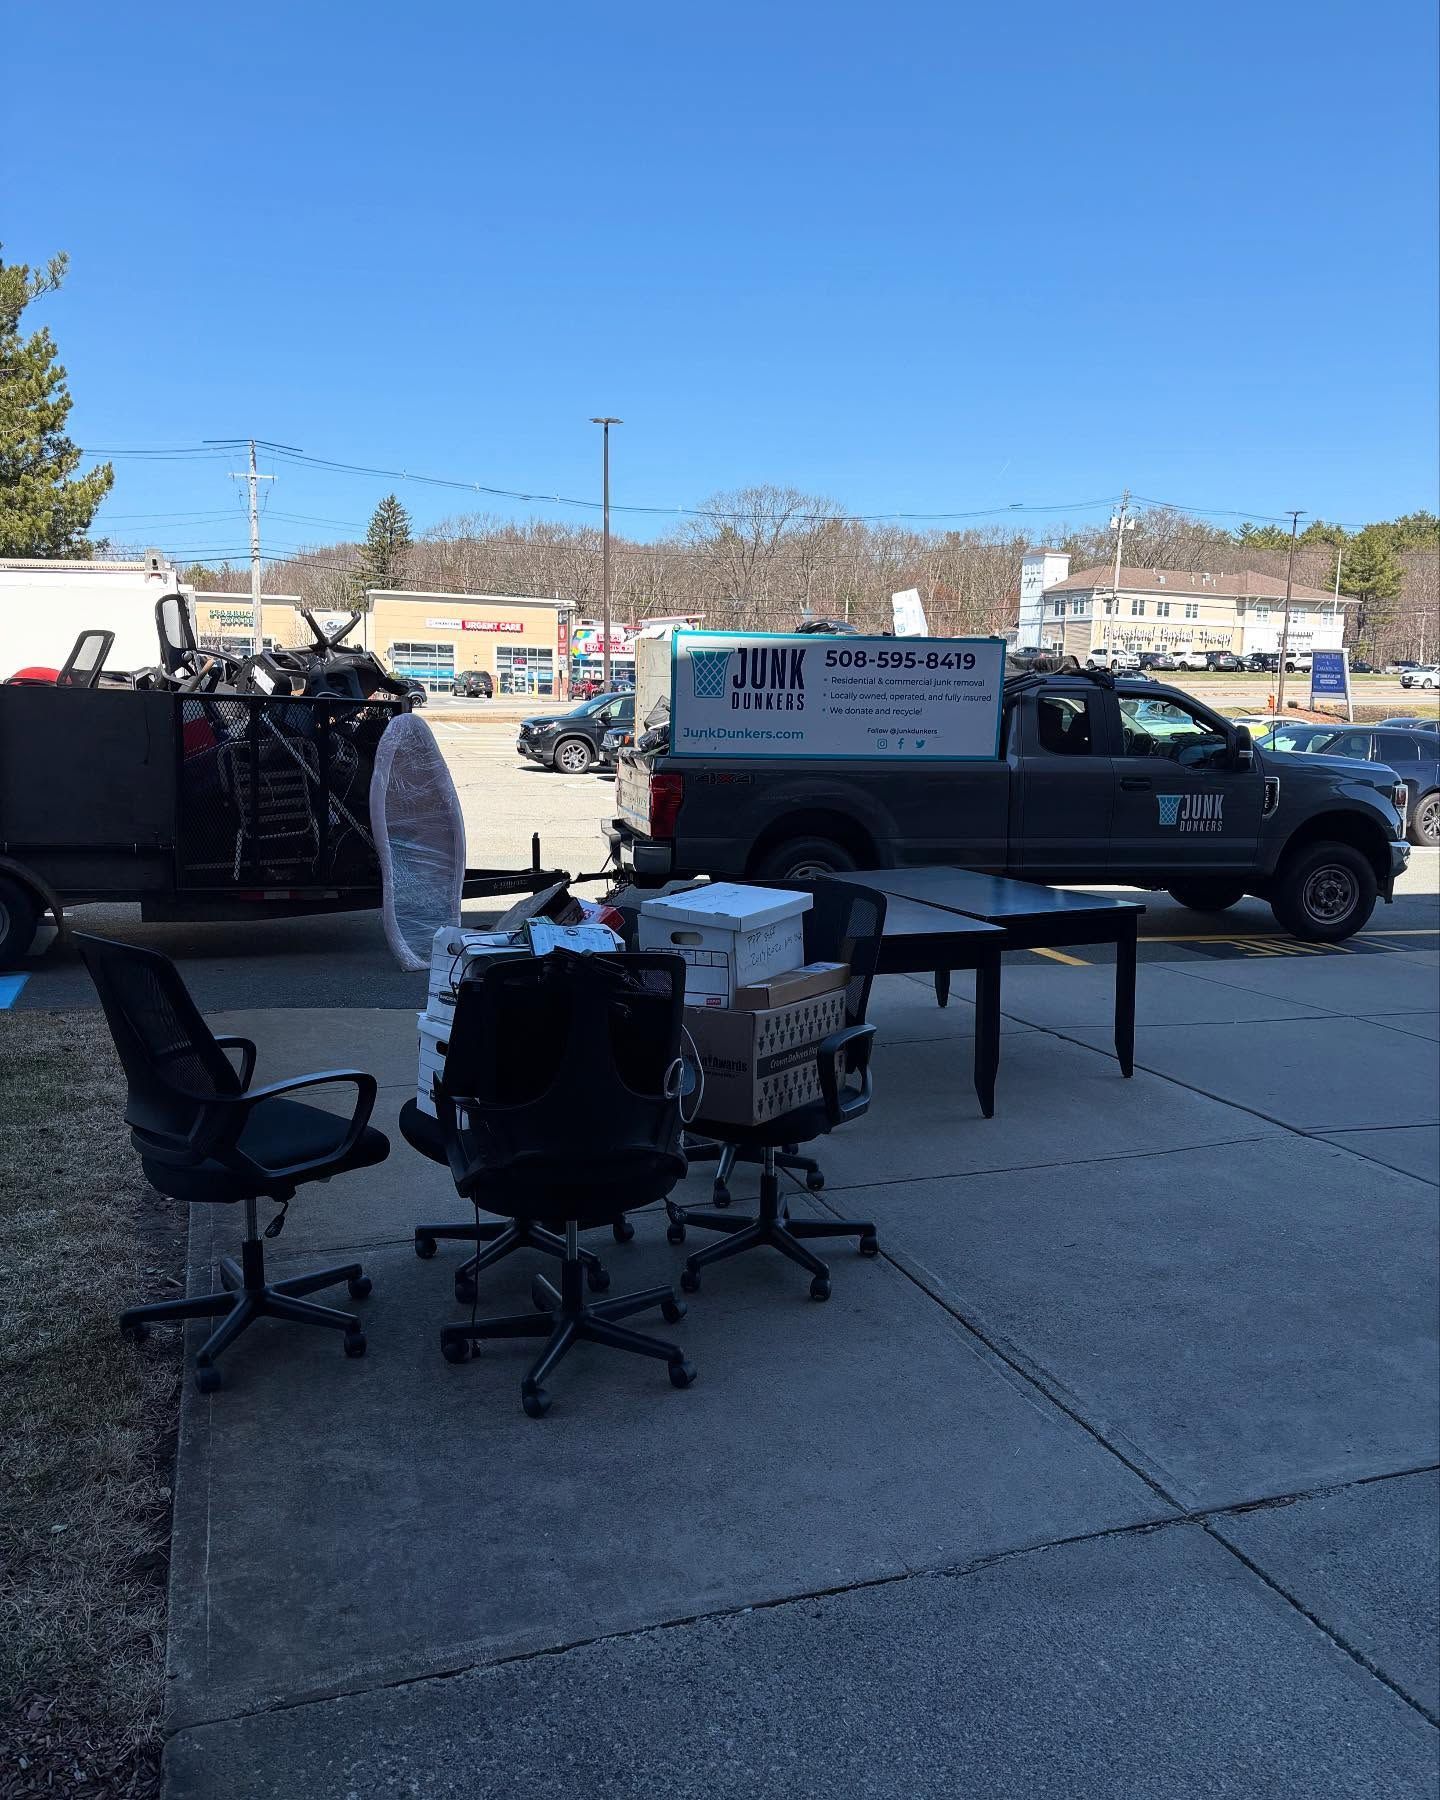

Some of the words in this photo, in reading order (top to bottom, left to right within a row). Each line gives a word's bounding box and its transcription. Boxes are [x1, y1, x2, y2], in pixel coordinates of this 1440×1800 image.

[209, 609, 254, 620] STARBUC
[465, 621, 498, 631] URGENT
[500, 623, 521, 632] CARE
[1104, 625, 1155, 642] Professional
[1161, 627, 1193, 643] Physical
[1200, 630, 1233, 646] Therapy
[824, 649, 976, 670] 508-595-8419
[732, 647, 806, 690] JUNK
[831, 676, 876, 685] Residential
[877, 677, 884, 685] &
[885, 677, 932, 686] commercial
[933, 678, 952, 687] junk
[953, 679, 985, 687] removal
[731, 691, 805, 711] DUNKERS
[830, 692, 857, 701] Locally
[859, 693, 888, 701] owned,
[889, 693, 926, 702] operated,
[928, 693, 943, 701] and
[945, 693, 961, 702] fully
[963, 694, 991, 702] insured
[830, 706, 843, 715] We
[844, 707, 873, 715] donate
[875, 707, 891, 715] and
[892, 708, 923, 716] recycle!
[682, 727, 804, 740] JunkDunkers.com
[1181, 794, 1225, 820] JUNK
[1180, 820, 1223, 832] DUNKERS
